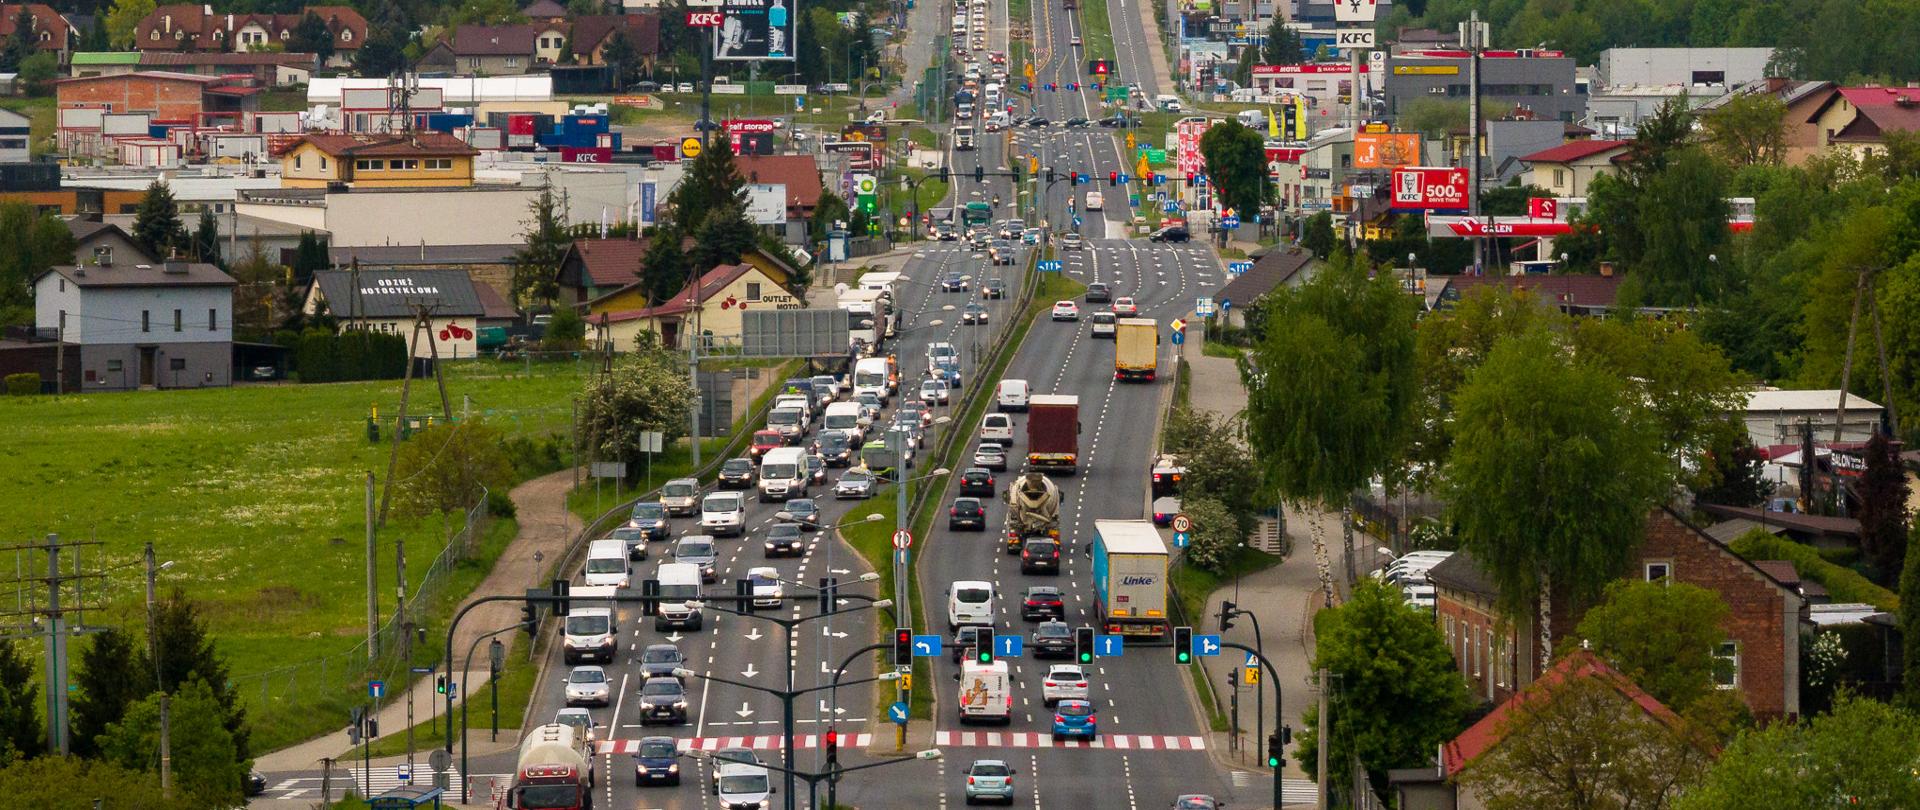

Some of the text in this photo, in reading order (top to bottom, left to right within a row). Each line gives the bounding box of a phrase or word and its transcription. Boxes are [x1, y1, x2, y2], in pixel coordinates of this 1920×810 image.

[690, 13, 721, 25] KFC
[1340, 33, 1371, 44] KFC
[729, 123, 773, 132] self storage
[576, 154, 597, 162] KFC
[378, 278, 413, 287] ODZIEŻ
[360, 286, 439, 295] MOTOCYKLOWA
[1177, 520, 1187, 529] 70
[1123, 576, 1153, 586] Linke
